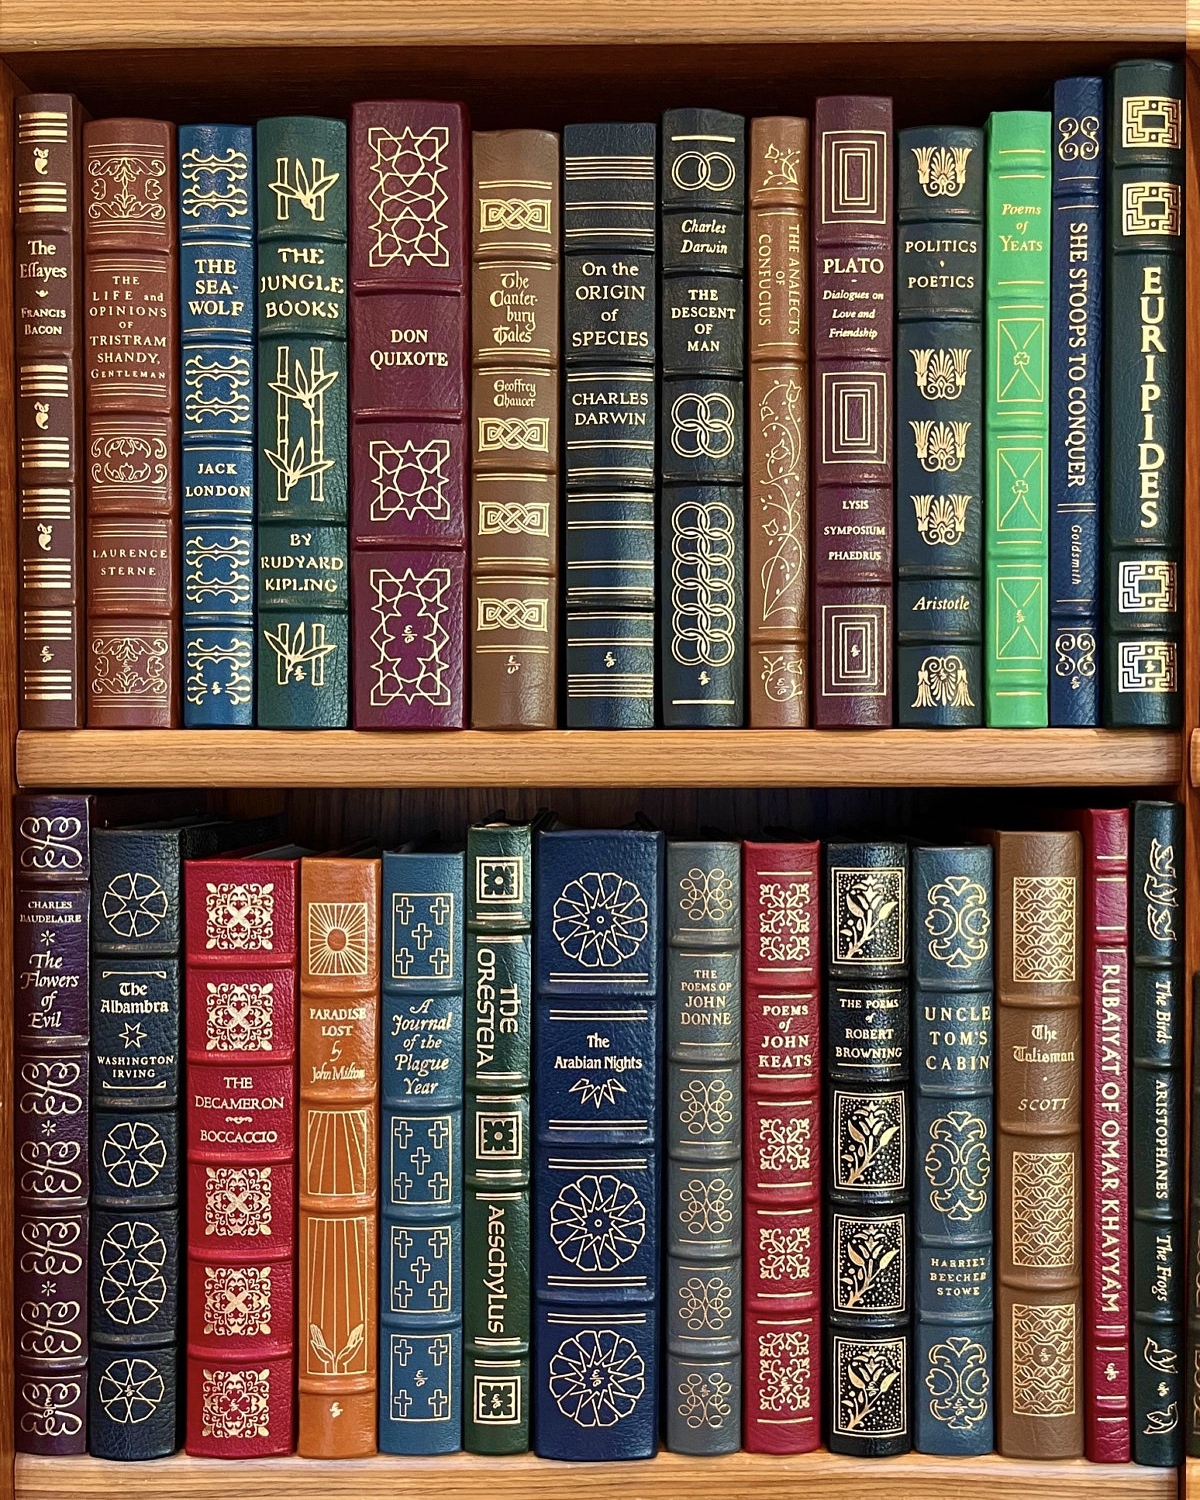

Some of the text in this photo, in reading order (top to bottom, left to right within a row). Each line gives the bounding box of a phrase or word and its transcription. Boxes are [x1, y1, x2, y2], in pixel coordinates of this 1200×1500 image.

[904, 239, 977, 254] POLITICS
[822, 257, 885, 275] PLATO
[907, 275, 974, 289] POETICS
[575, 284, 646, 301] ORIGIN
[187, 300, 245, 316] WOLF
[670, 306, 737, 320] DESCENT
[390, 329, 429, 343] DON
[572, 330, 649, 348] SPECIES
[687, 340, 720, 352] MAN
[369, 349, 449, 371] QUIXOTE
[1064, 222, 1089, 488] SHE STOOPS TO CONQUER
[1137, 266, 1167, 529] EURIPIDES
[574, 411, 647, 426] DARWIN
[197, 462, 238, 475] JACK
[823, 525, 886, 536] SYMPOSIUM
[260, 555, 344, 571] RUDYARD
[100, 566, 156, 576] STERNE
[265, 578, 338, 593] KIPLING
[912, 595, 970, 611] Aristotle
[680, 1012, 732, 1026] DONNE
[924, 1005, 991, 1022] UNCLE
[321, 1025, 354, 1037] LOST
[845, 1024, 895, 1041] ROBERT
[761, 1034, 810, 1049] JOHN
[758, 1054, 813, 1068] KEATS
[835, 1046, 903, 1062] BROWNING
[553, 1055, 643, 1073] Arabian Nights
[112, 1068, 156, 1079] IRVING
[194, 1095, 285, 1110] DECAMERON
[1017, 1097, 1070, 1111] SCOTT
[1101, 1081, 1121, 1113] OF
[200, 1129, 278, 1144] BOCCACCIO
[1101, 1119, 1122, 1192] OMAR
